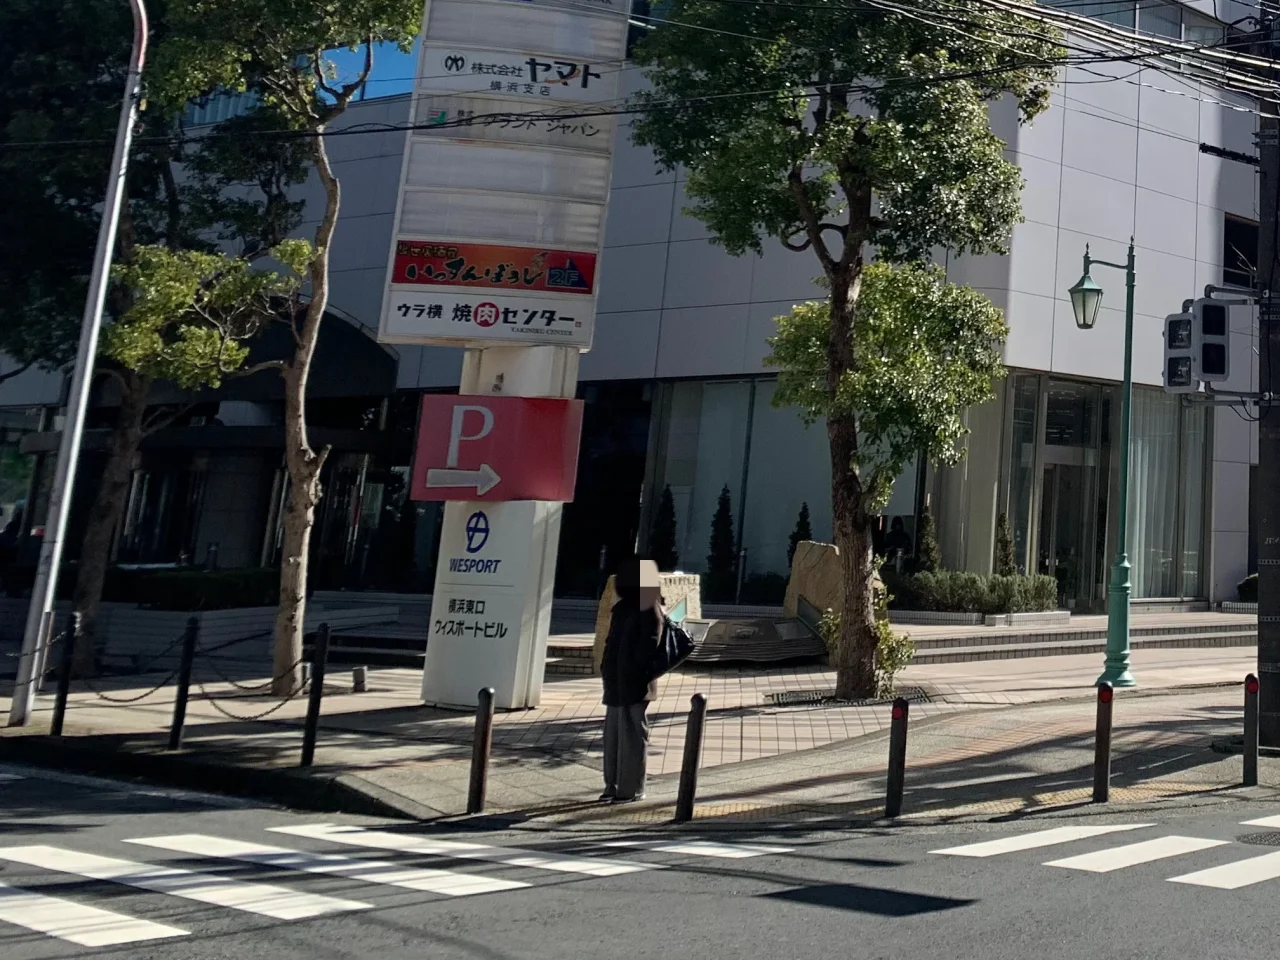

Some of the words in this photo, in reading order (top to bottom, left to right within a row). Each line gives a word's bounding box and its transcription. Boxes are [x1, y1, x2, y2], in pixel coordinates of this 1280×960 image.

[471, 62, 524, 78] 株式会社
[525, 58, 601, 88] ヤマト
[549, 269, 580, 286] 2F
[397, 303, 444, 319] ウラ横
[451, 301, 575, 328] 焼肉センター
[446, 405, 495, 468] P
[449, 558, 502, 574] WESPORT
[448, 598, 485, 615] 横浜東口
